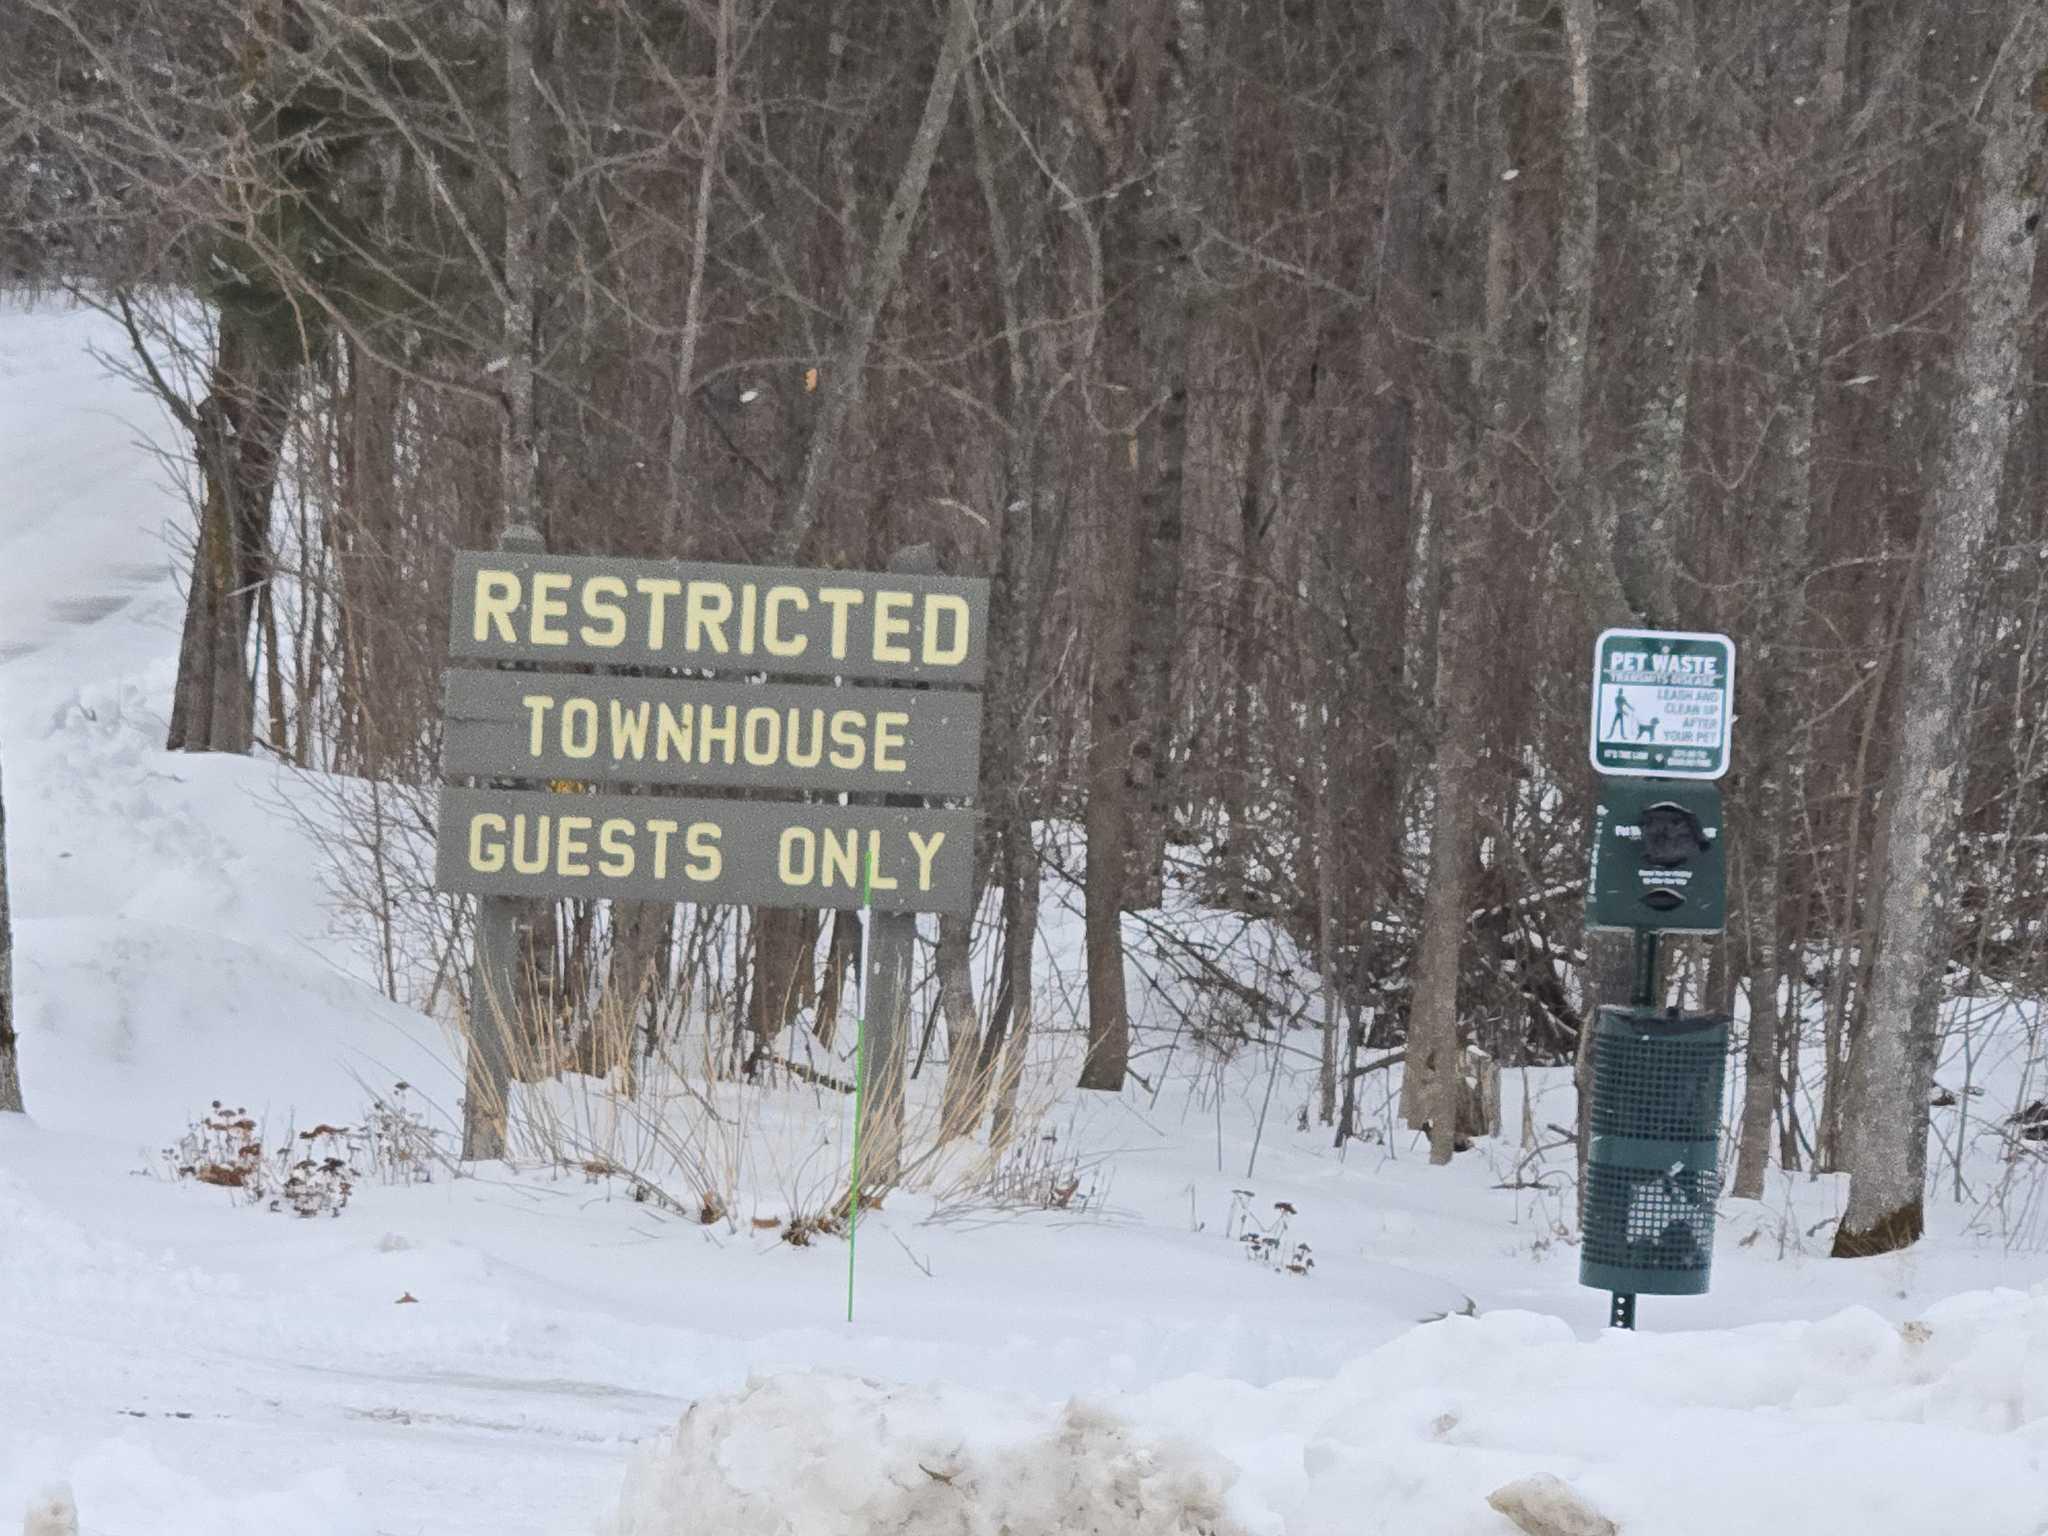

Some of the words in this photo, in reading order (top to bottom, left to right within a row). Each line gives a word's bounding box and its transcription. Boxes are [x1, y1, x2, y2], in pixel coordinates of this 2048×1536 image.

[473, 569, 970, 667] RESTRICTED
[1611, 651, 1649, 671] PET
[1652, 654, 1717, 674] WASTE
[1657, 689, 1693, 701] LEASH
[1695, 691, 1717, 702] AND
[1664, 703, 1700, 715] CLEAN
[1703, 705, 1716, 715] UP
[1683, 718, 1716, 729] AFTER
[522, 694, 911, 772] TOWNHOUSE
[1664, 731, 1694, 742] YOUR
[1696, 732, 1716, 743] PET
[468, 813, 723, 881] GUESTS
[778, 826, 946, 892] ONLY
